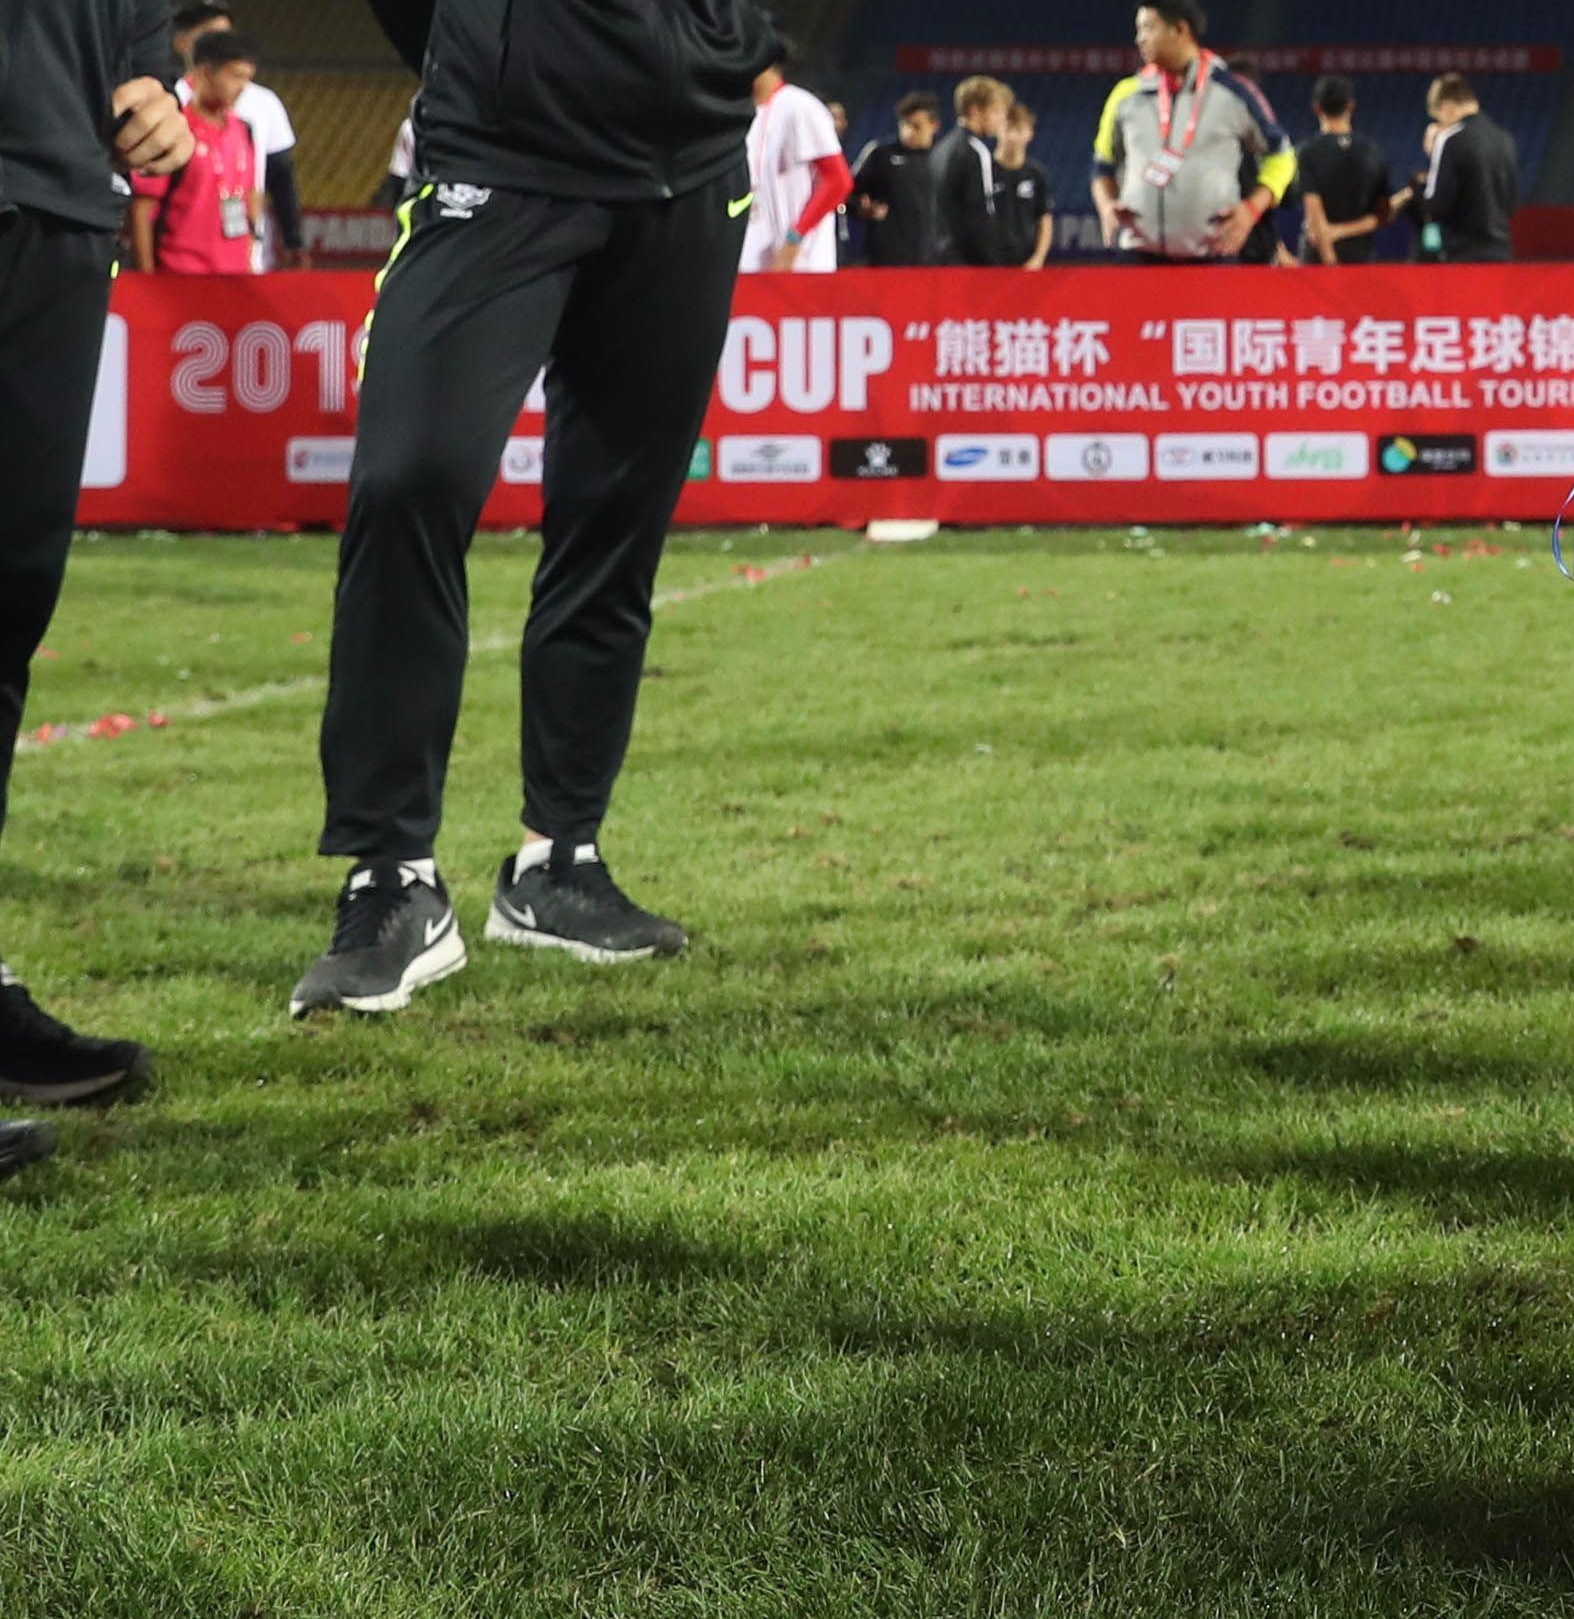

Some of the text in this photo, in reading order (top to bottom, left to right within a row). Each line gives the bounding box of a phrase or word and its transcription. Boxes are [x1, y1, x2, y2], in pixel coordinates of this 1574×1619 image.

[170, 319, 368, 414] 201
[717, 316, 893, 413] CUP
[909, 382, 1169, 412] INTERNATIONAL
[1178, 381, 1289, 411] YOUTH
[1297, 380, 1471, 410] FOOTBALL
